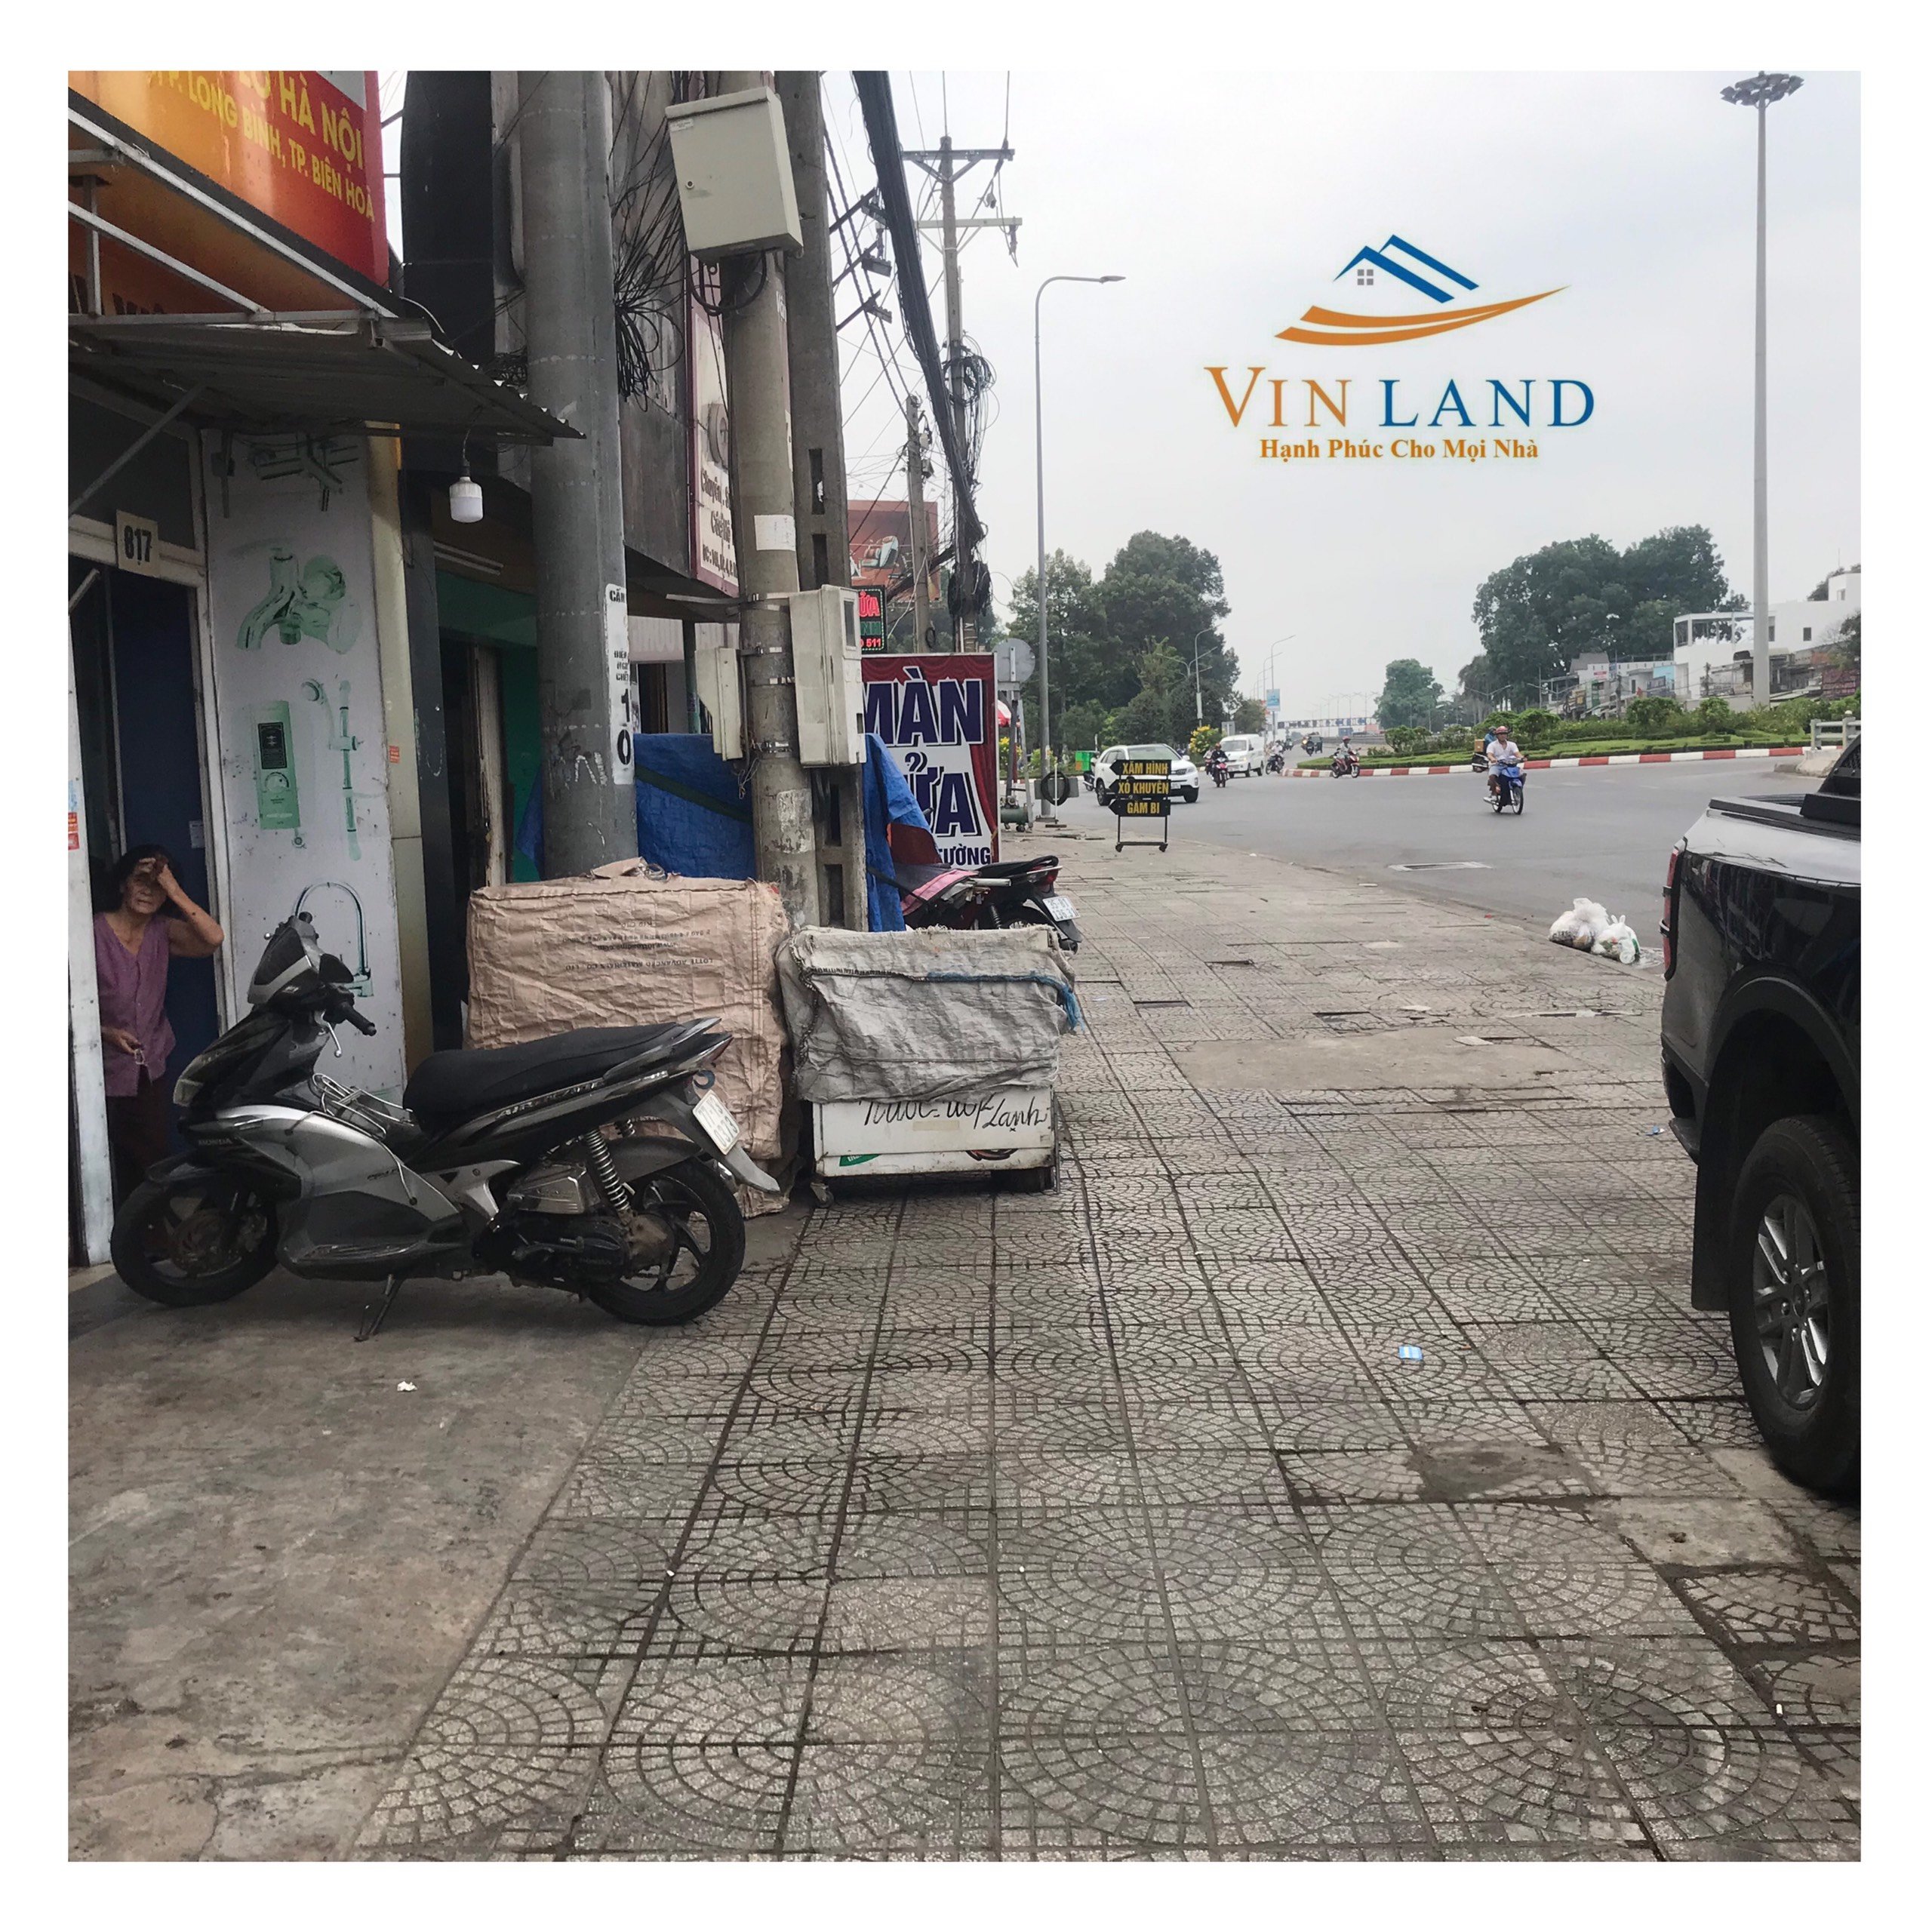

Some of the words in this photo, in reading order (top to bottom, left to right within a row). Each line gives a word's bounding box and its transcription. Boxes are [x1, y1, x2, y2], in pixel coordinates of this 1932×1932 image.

[278, 71, 315, 136] HÀ
[321, 101, 363, 174] NỘI
[188, 71, 238, 128] LONG
[242, 101, 286, 168] BÌNH,
[288, 138, 308, 177] TP.
[311, 155, 342, 200] BIÊN
[345, 185, 375, 223] HOÀ
[866, 638, 881, 648] 511
[863, 666, 983, 747] MÀN
[1146, 761, 1168, 774] HÌNH
[1133, 780, 1169, 795] KHUYÊN
[1150, 802, 1160, 814] BI
[938, 843, 991, 866] ƯỜNG
